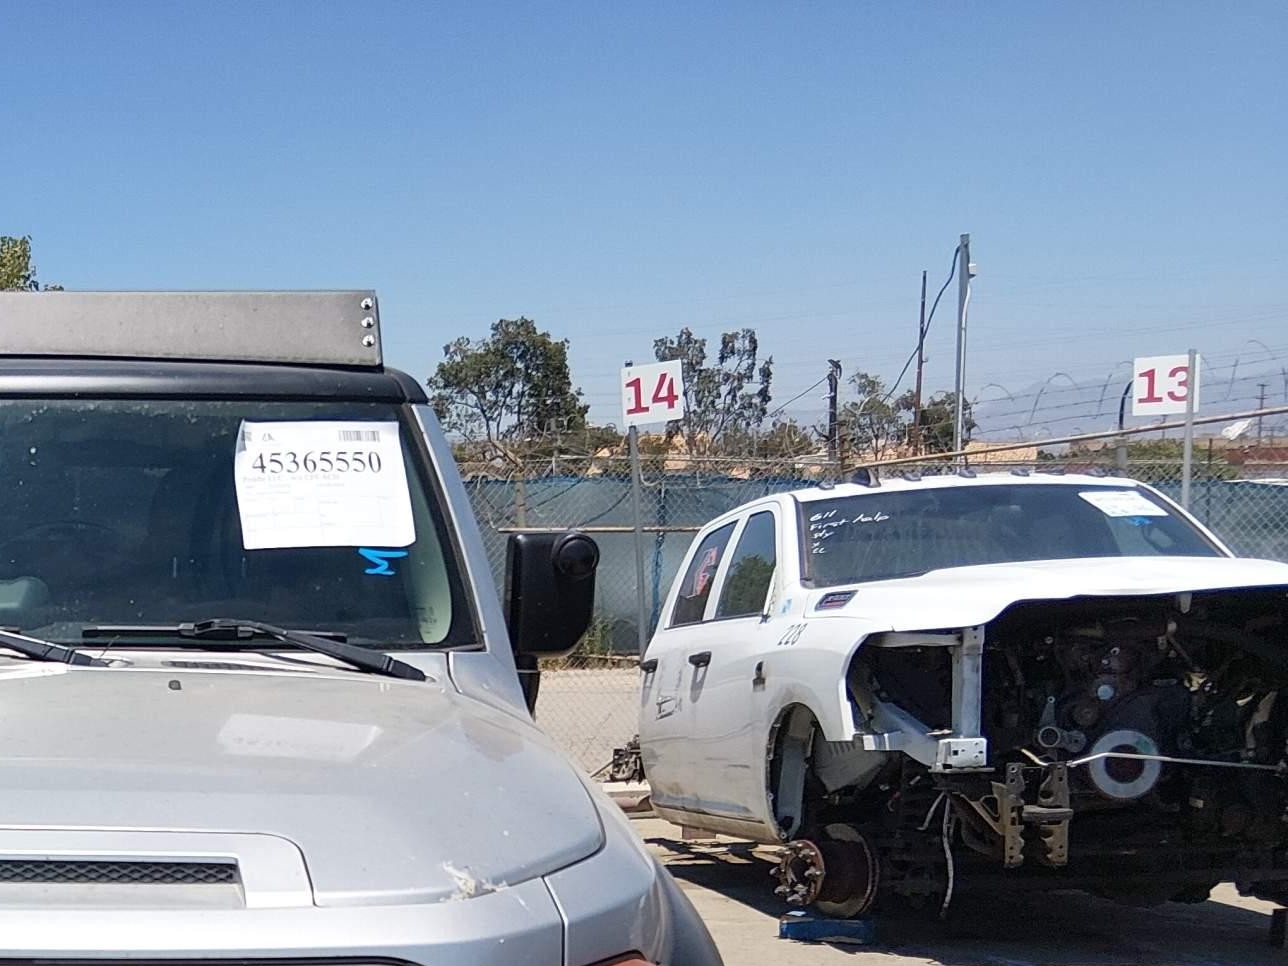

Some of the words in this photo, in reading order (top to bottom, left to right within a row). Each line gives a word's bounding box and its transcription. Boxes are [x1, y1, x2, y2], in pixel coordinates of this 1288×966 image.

[625, 373, 679, 415] 14
[1137, 366, 1190, 403] 13
[251, 451, 382, 474] 45365550
